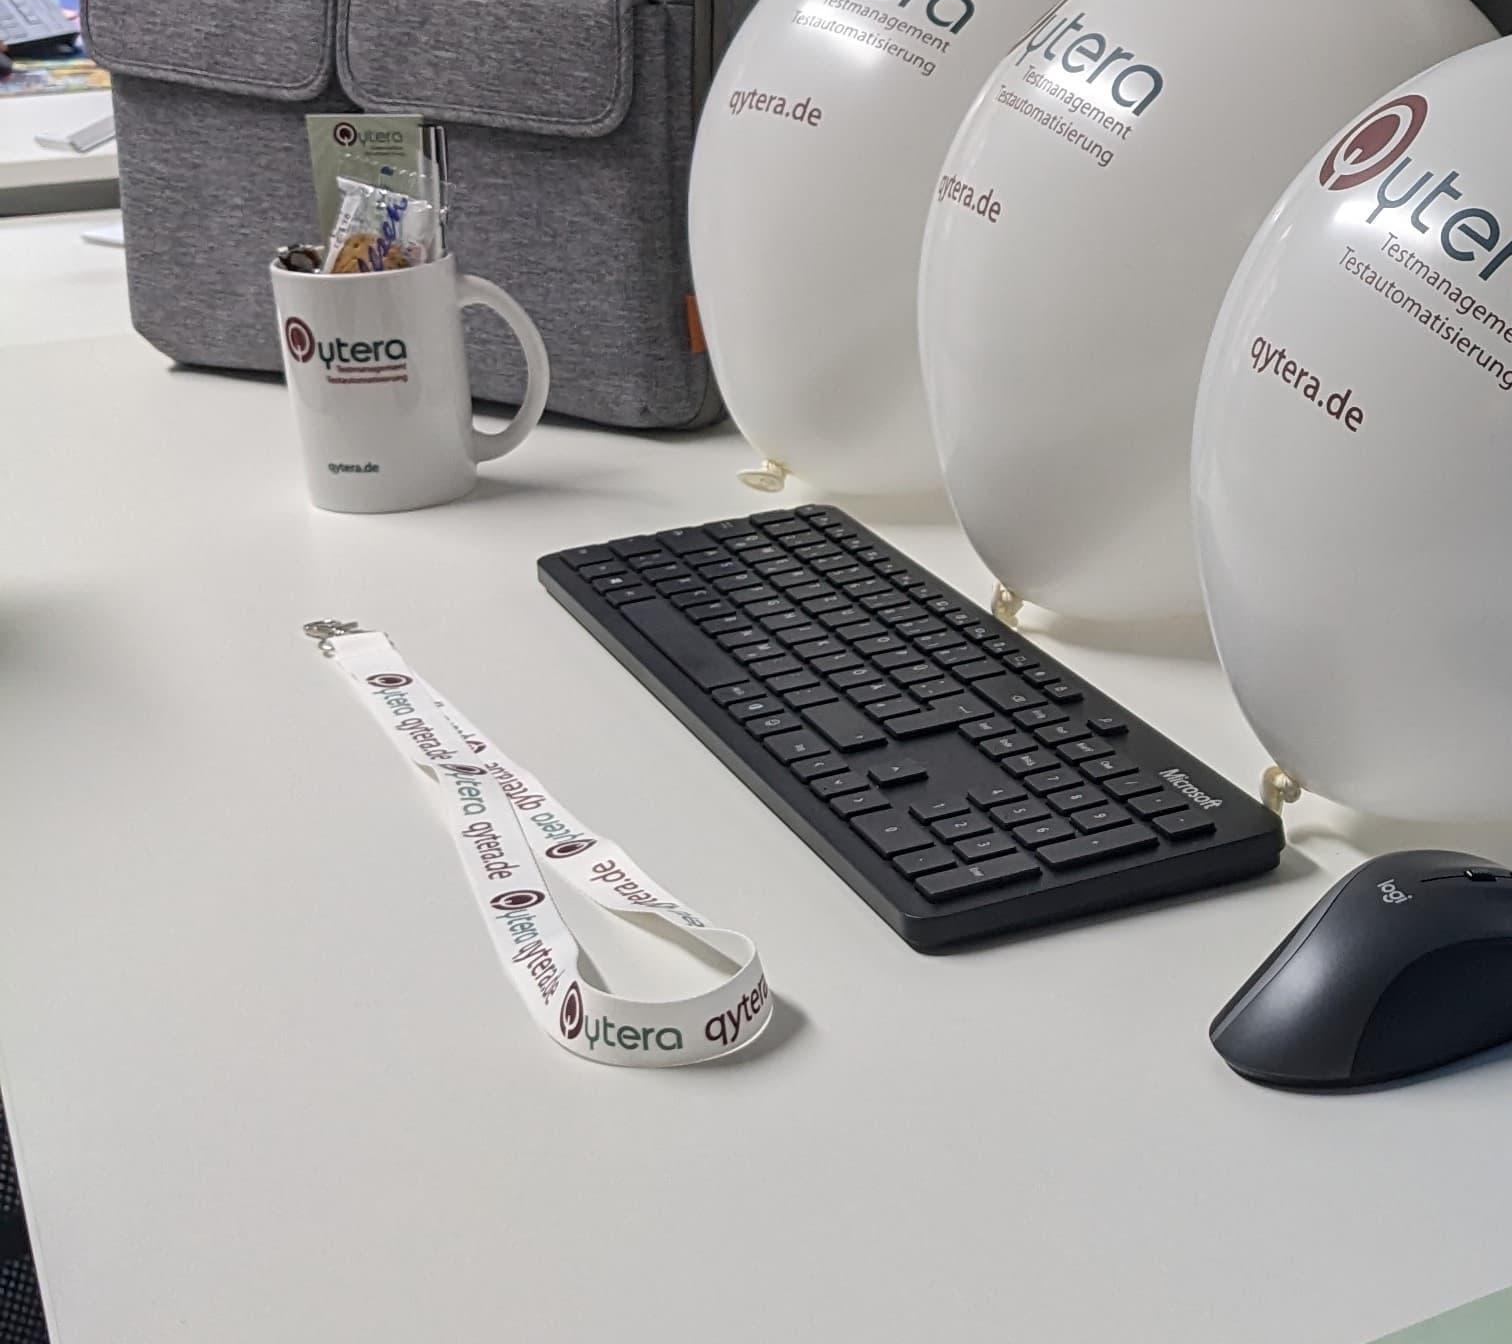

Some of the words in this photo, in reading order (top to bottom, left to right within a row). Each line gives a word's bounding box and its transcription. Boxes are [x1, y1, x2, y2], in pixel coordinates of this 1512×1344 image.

[792, 9, 936, 77] Testautomatisierung
[1010, 10, 1164, 117] ytera
[729, 88, 823, 127] qytera.de
[995, 84, 1114, 168] Testautomatisierung
[1022, 64, 1133, 140] Testmanagement
[285, 316, 408, 369] Qytera
[1251, 336, 1365, 433] qytera.de
[328, 461, 379, 475] qytera.de
[1158, 768, 1223, 810] Microsoft
[1377, 878, 1413, 904] logi
[462, 821, 520, 881] qytera.de
[559, 980, 684, 1051] Qytera
